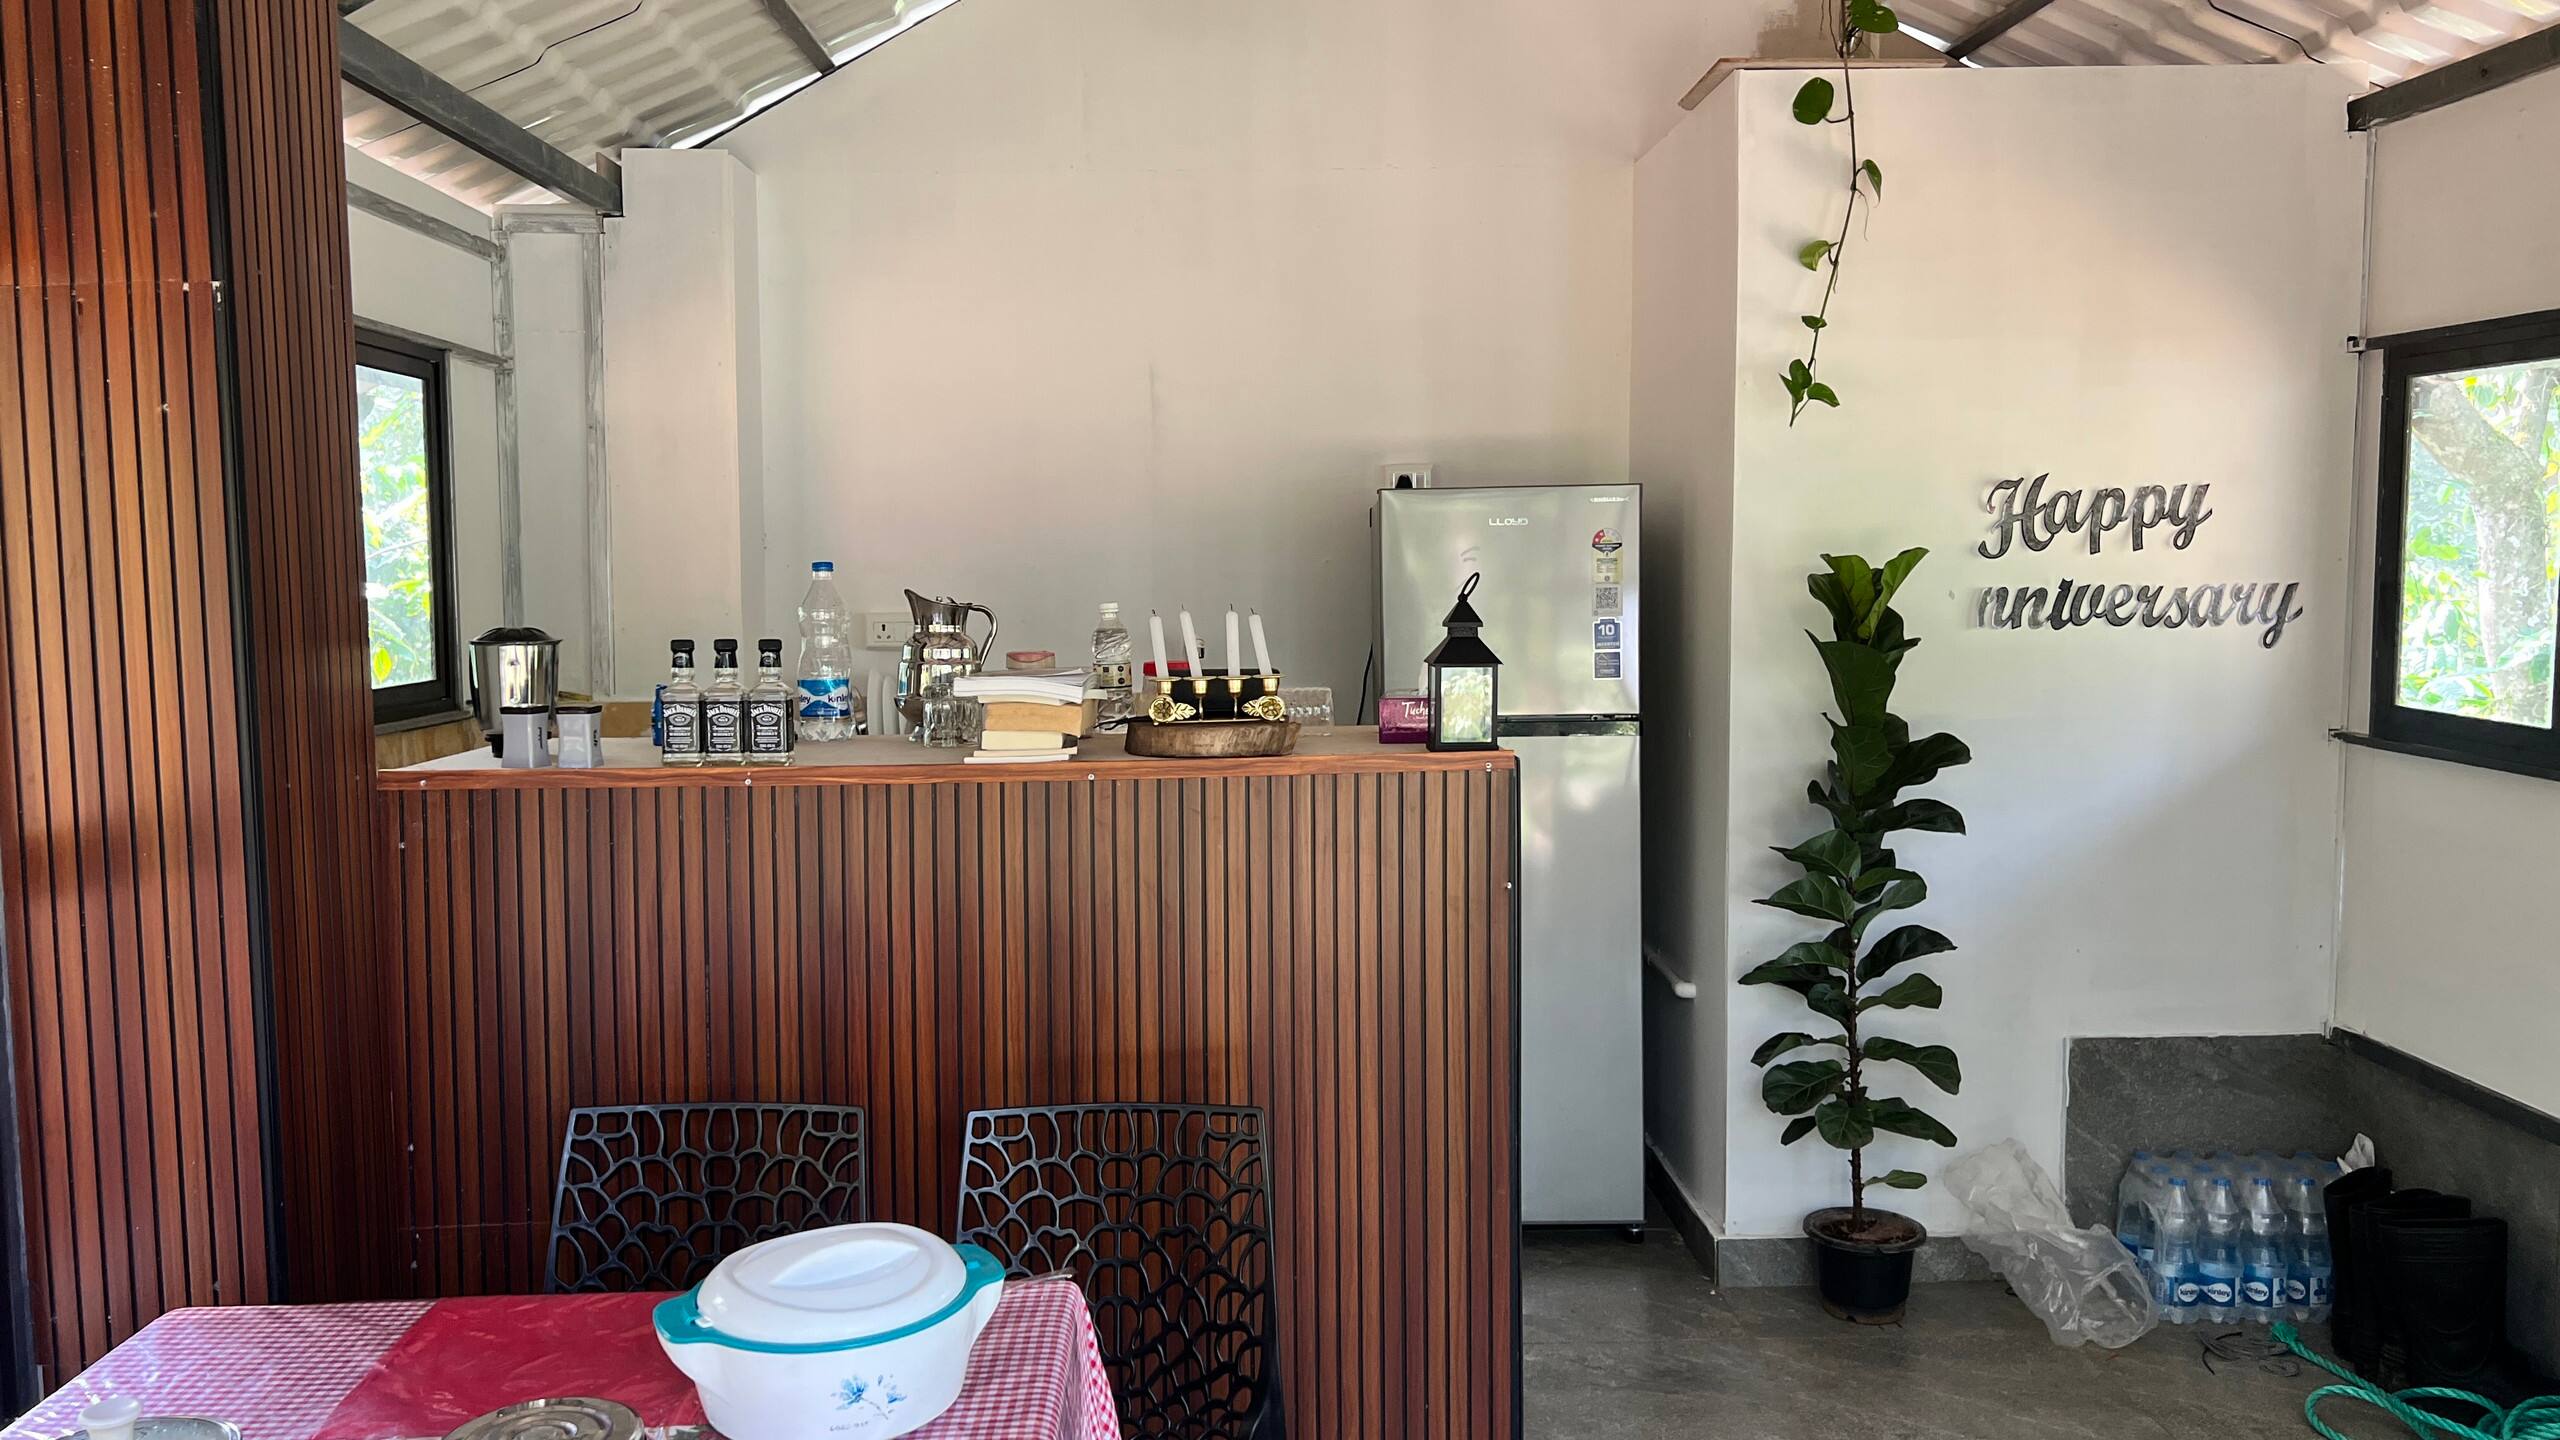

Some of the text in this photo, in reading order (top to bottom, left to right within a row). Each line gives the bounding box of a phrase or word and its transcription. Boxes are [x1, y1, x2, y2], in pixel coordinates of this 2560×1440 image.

[1978, 472, 2213, 559] Happy
[1598, 624, 1615, 636] 10
[1978, 578, 2303, 649] nniversary
